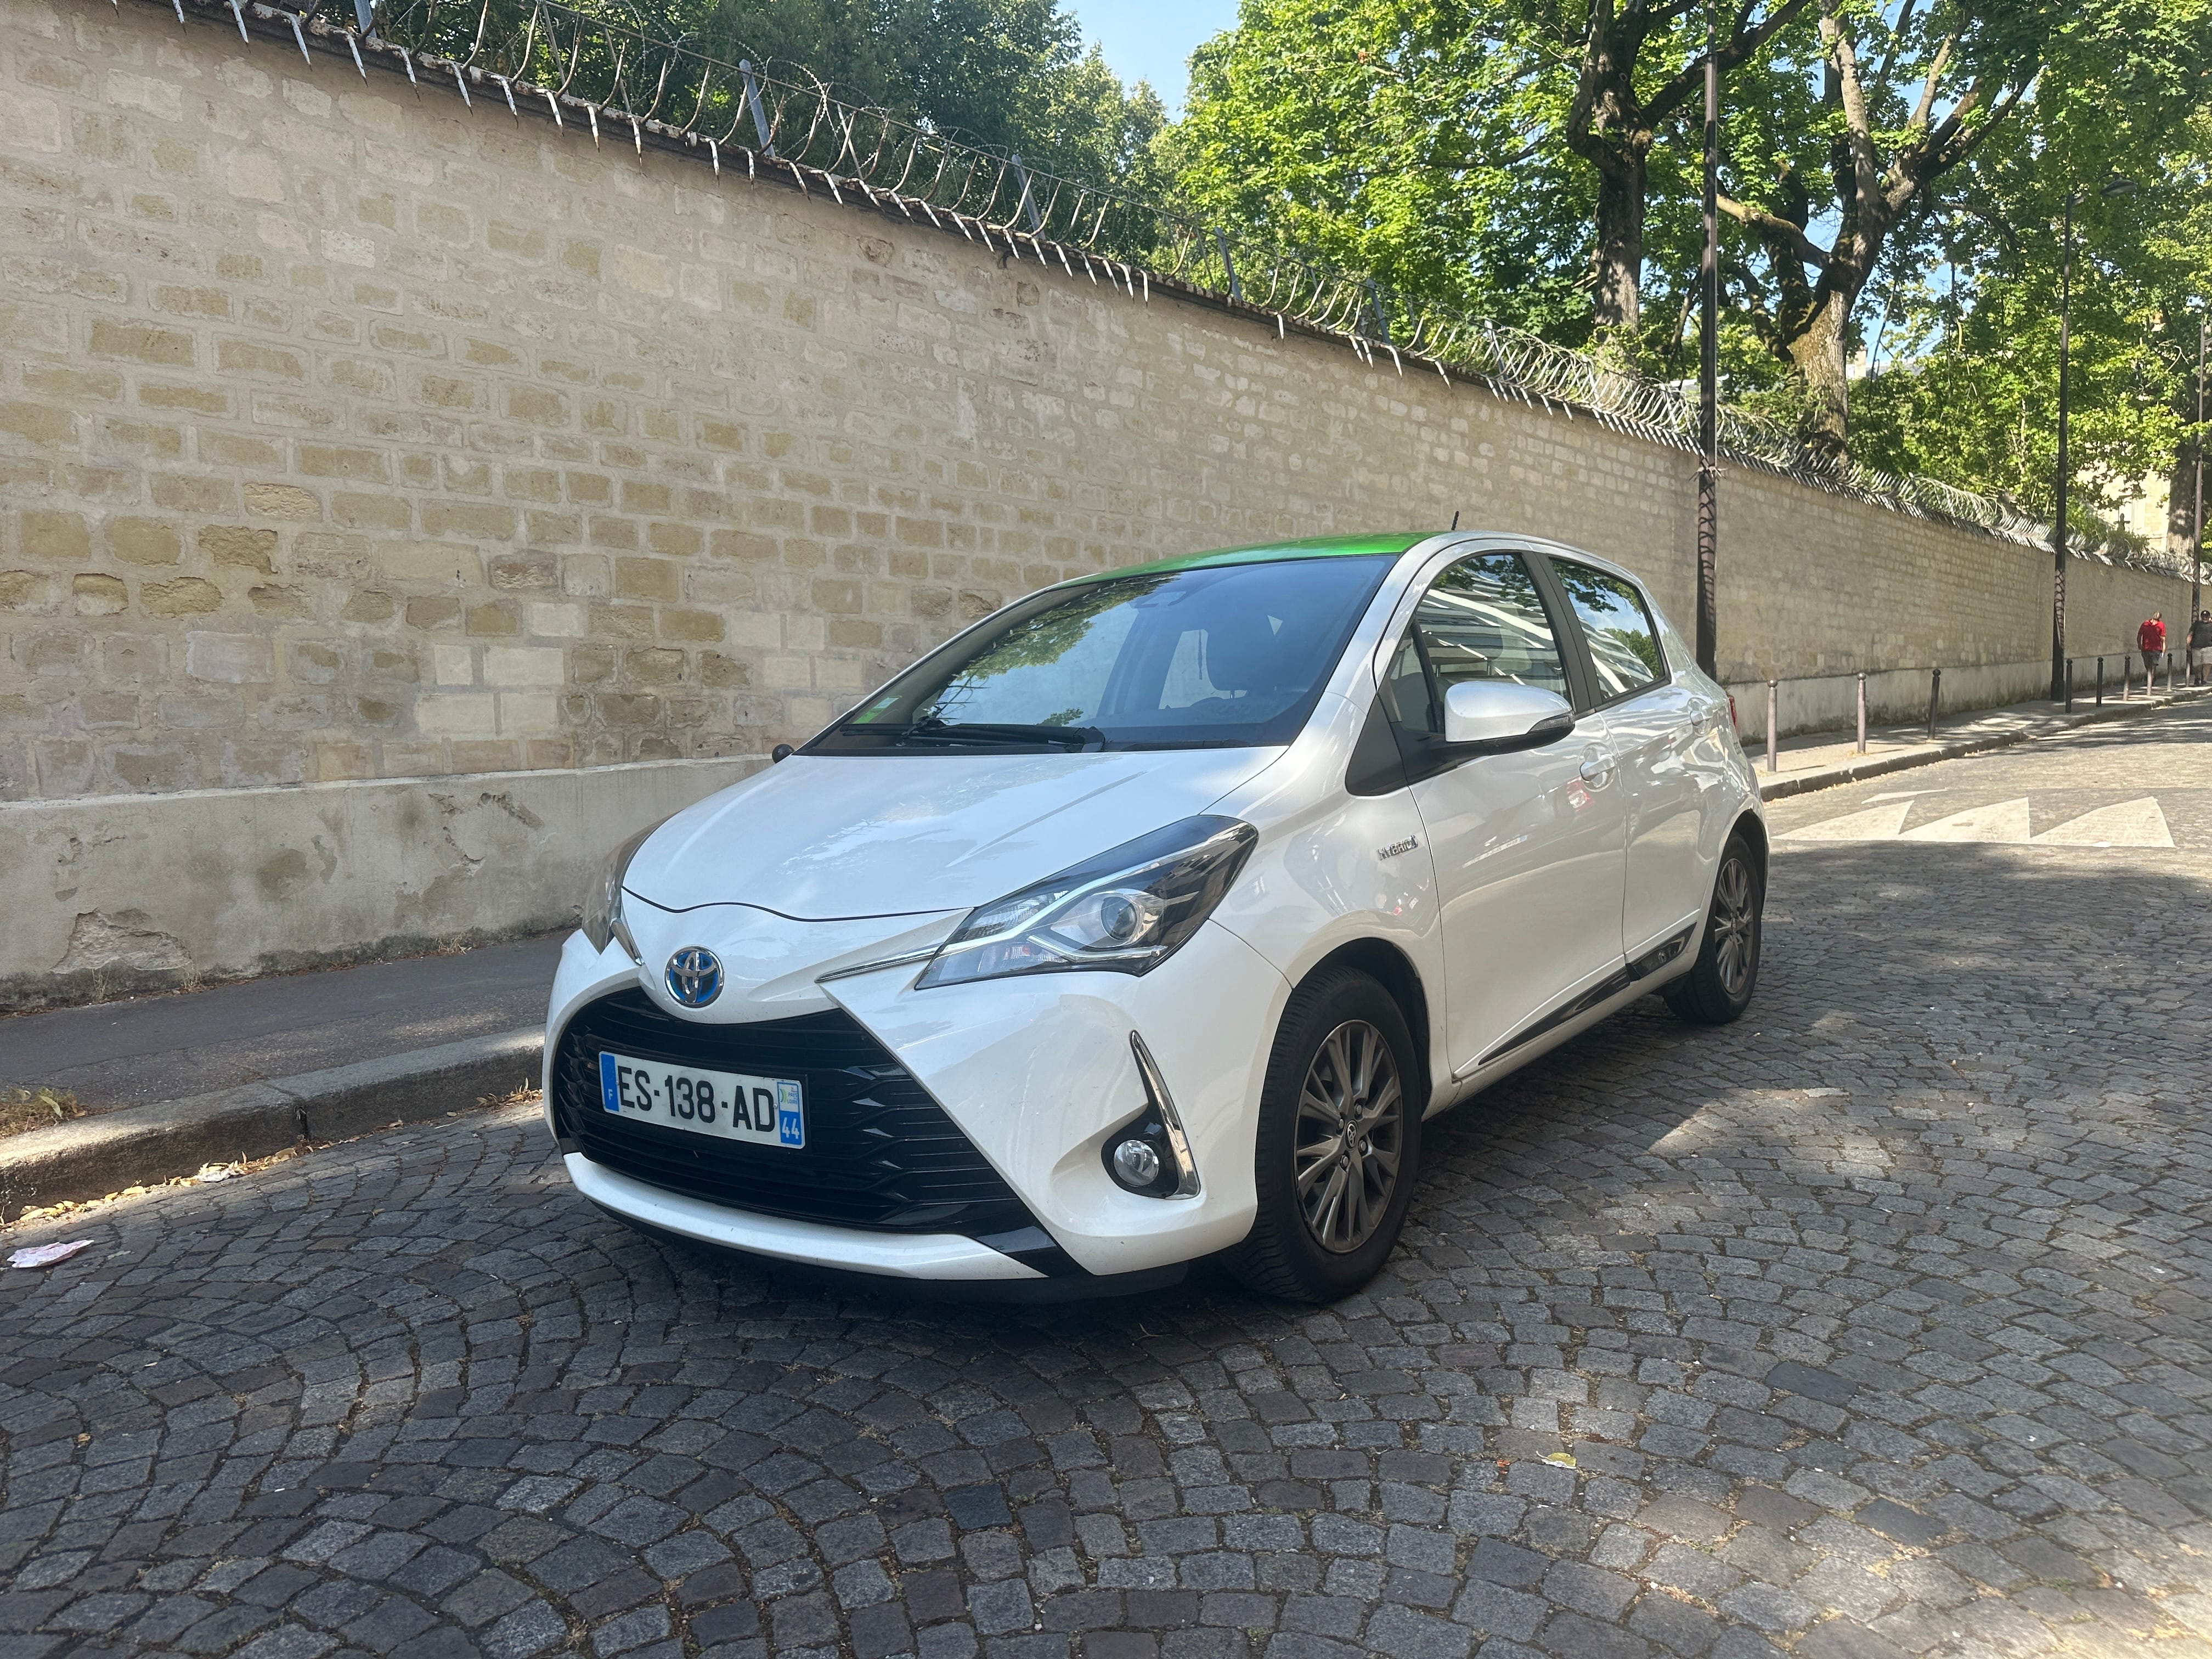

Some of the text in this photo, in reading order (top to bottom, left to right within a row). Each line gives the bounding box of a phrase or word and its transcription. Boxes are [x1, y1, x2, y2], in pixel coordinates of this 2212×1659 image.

[608, 1088, 613, 1101] F
[617, 1065, 776, 1132] ES-138-AD
[782, 1117, 800, 1139] 44
